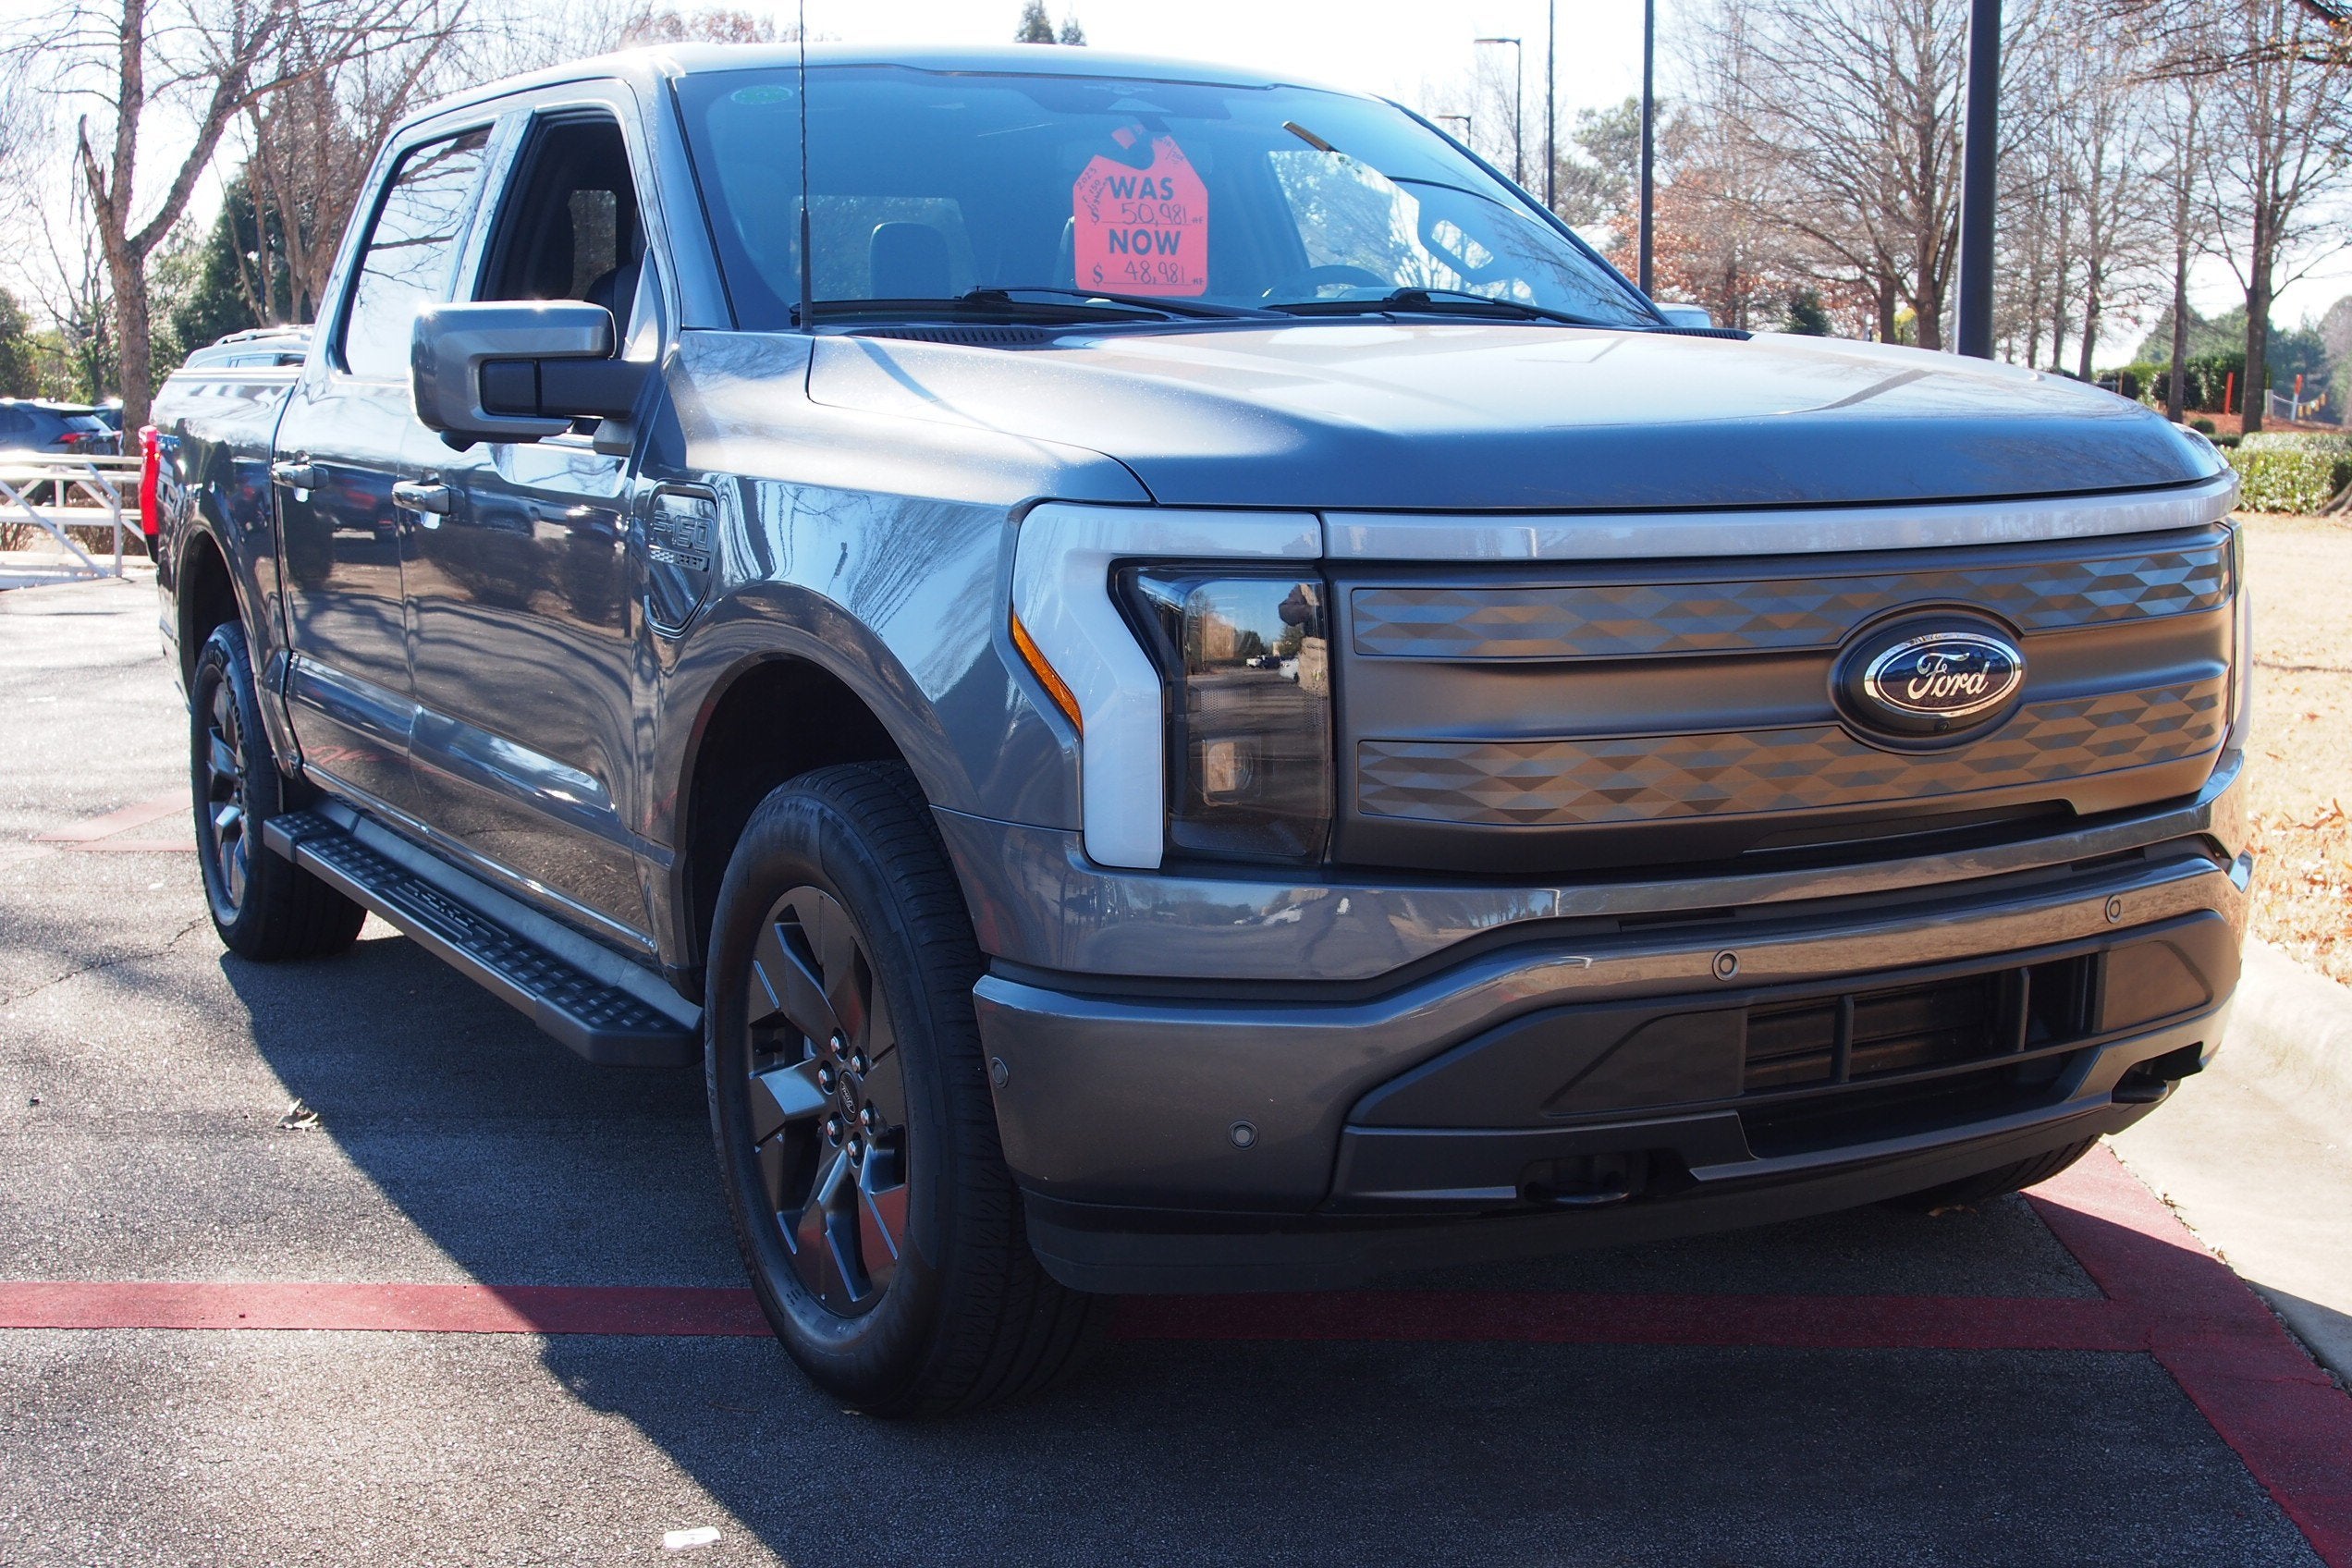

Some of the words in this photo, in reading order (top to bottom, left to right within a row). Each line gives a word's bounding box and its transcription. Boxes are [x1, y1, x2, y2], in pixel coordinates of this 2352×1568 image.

[1076, 166, 1097, 190] 2023
[1109, 176, 1174, 201] WAS
[1121, 202, 1187, 227] 50,981
[1109, 228, 1182, 255] NOW
[1093, 262, 1104, 287] $
[1124, 260, 1185, 285] 48,981
[1907, 651, 1991, 701] Ford
